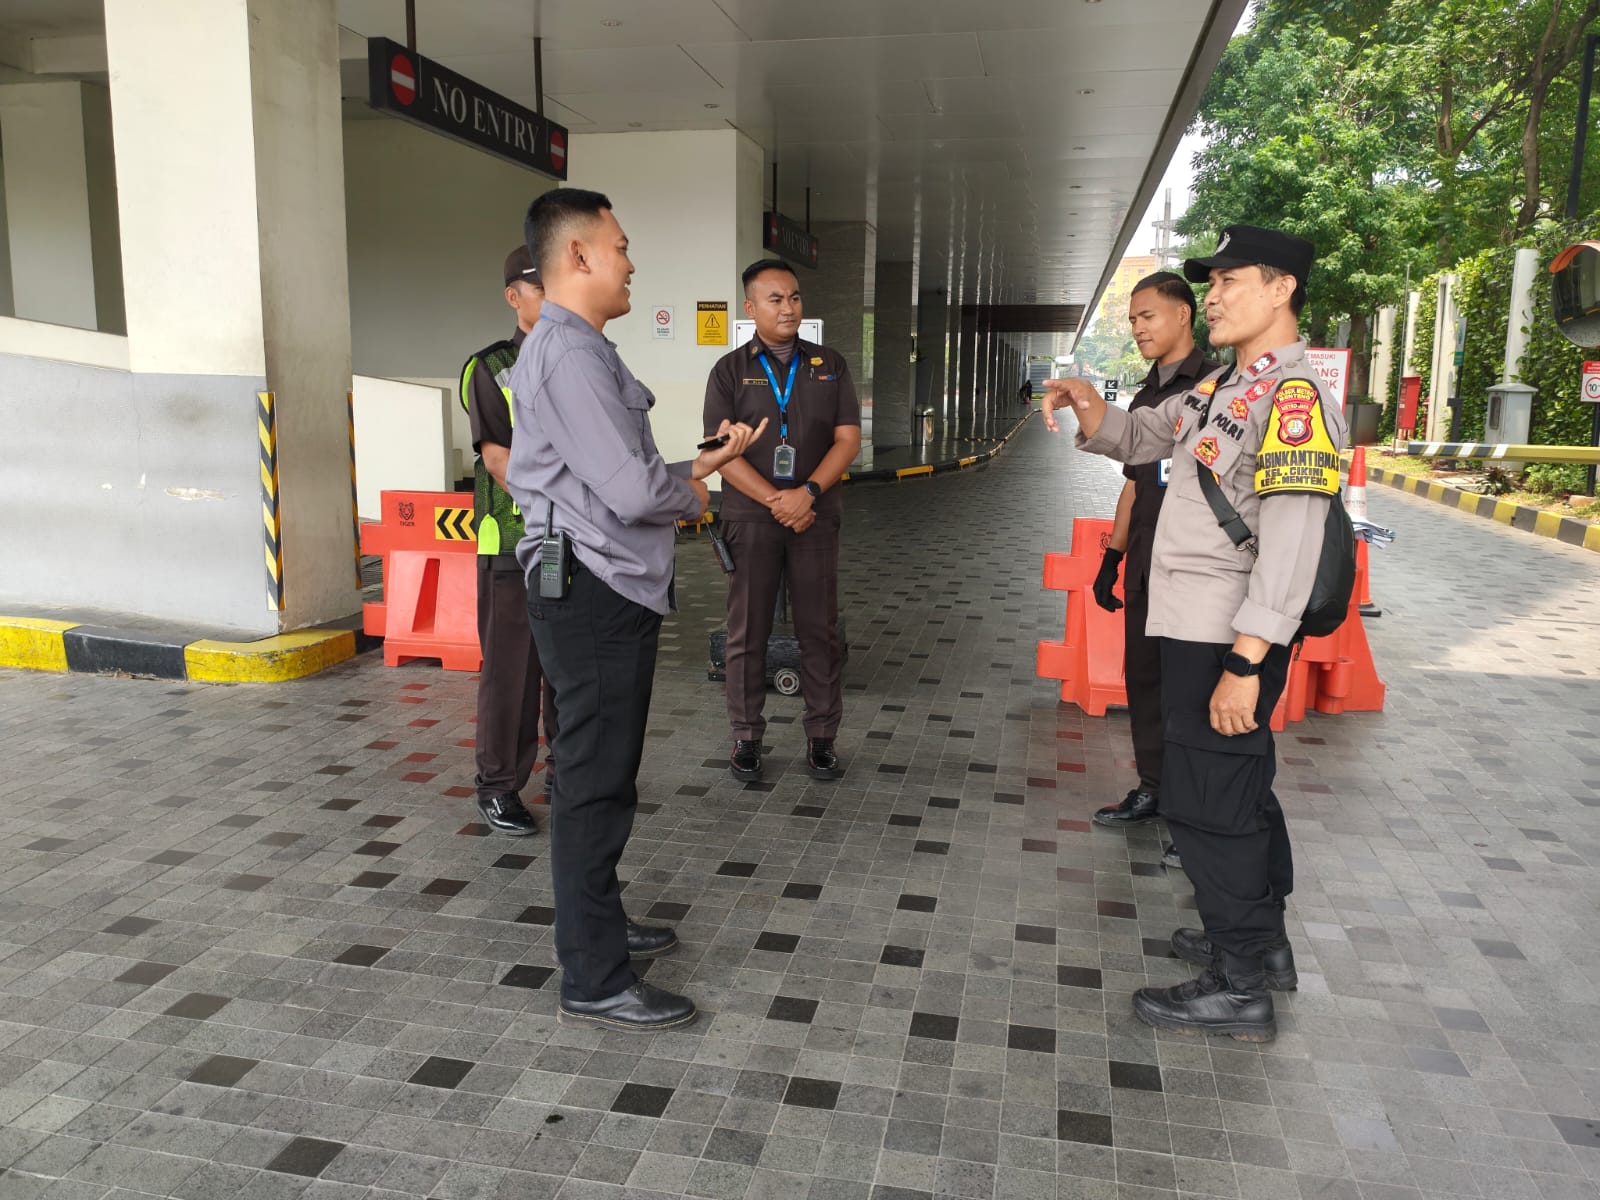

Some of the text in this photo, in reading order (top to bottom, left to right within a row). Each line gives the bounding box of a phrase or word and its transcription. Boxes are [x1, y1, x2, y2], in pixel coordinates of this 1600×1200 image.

[433, 77, 540, 154] NO ENTRY
[1211, 412, 1245, 441] POLRI
[1290, 467, 1323, 477] CIKINI
